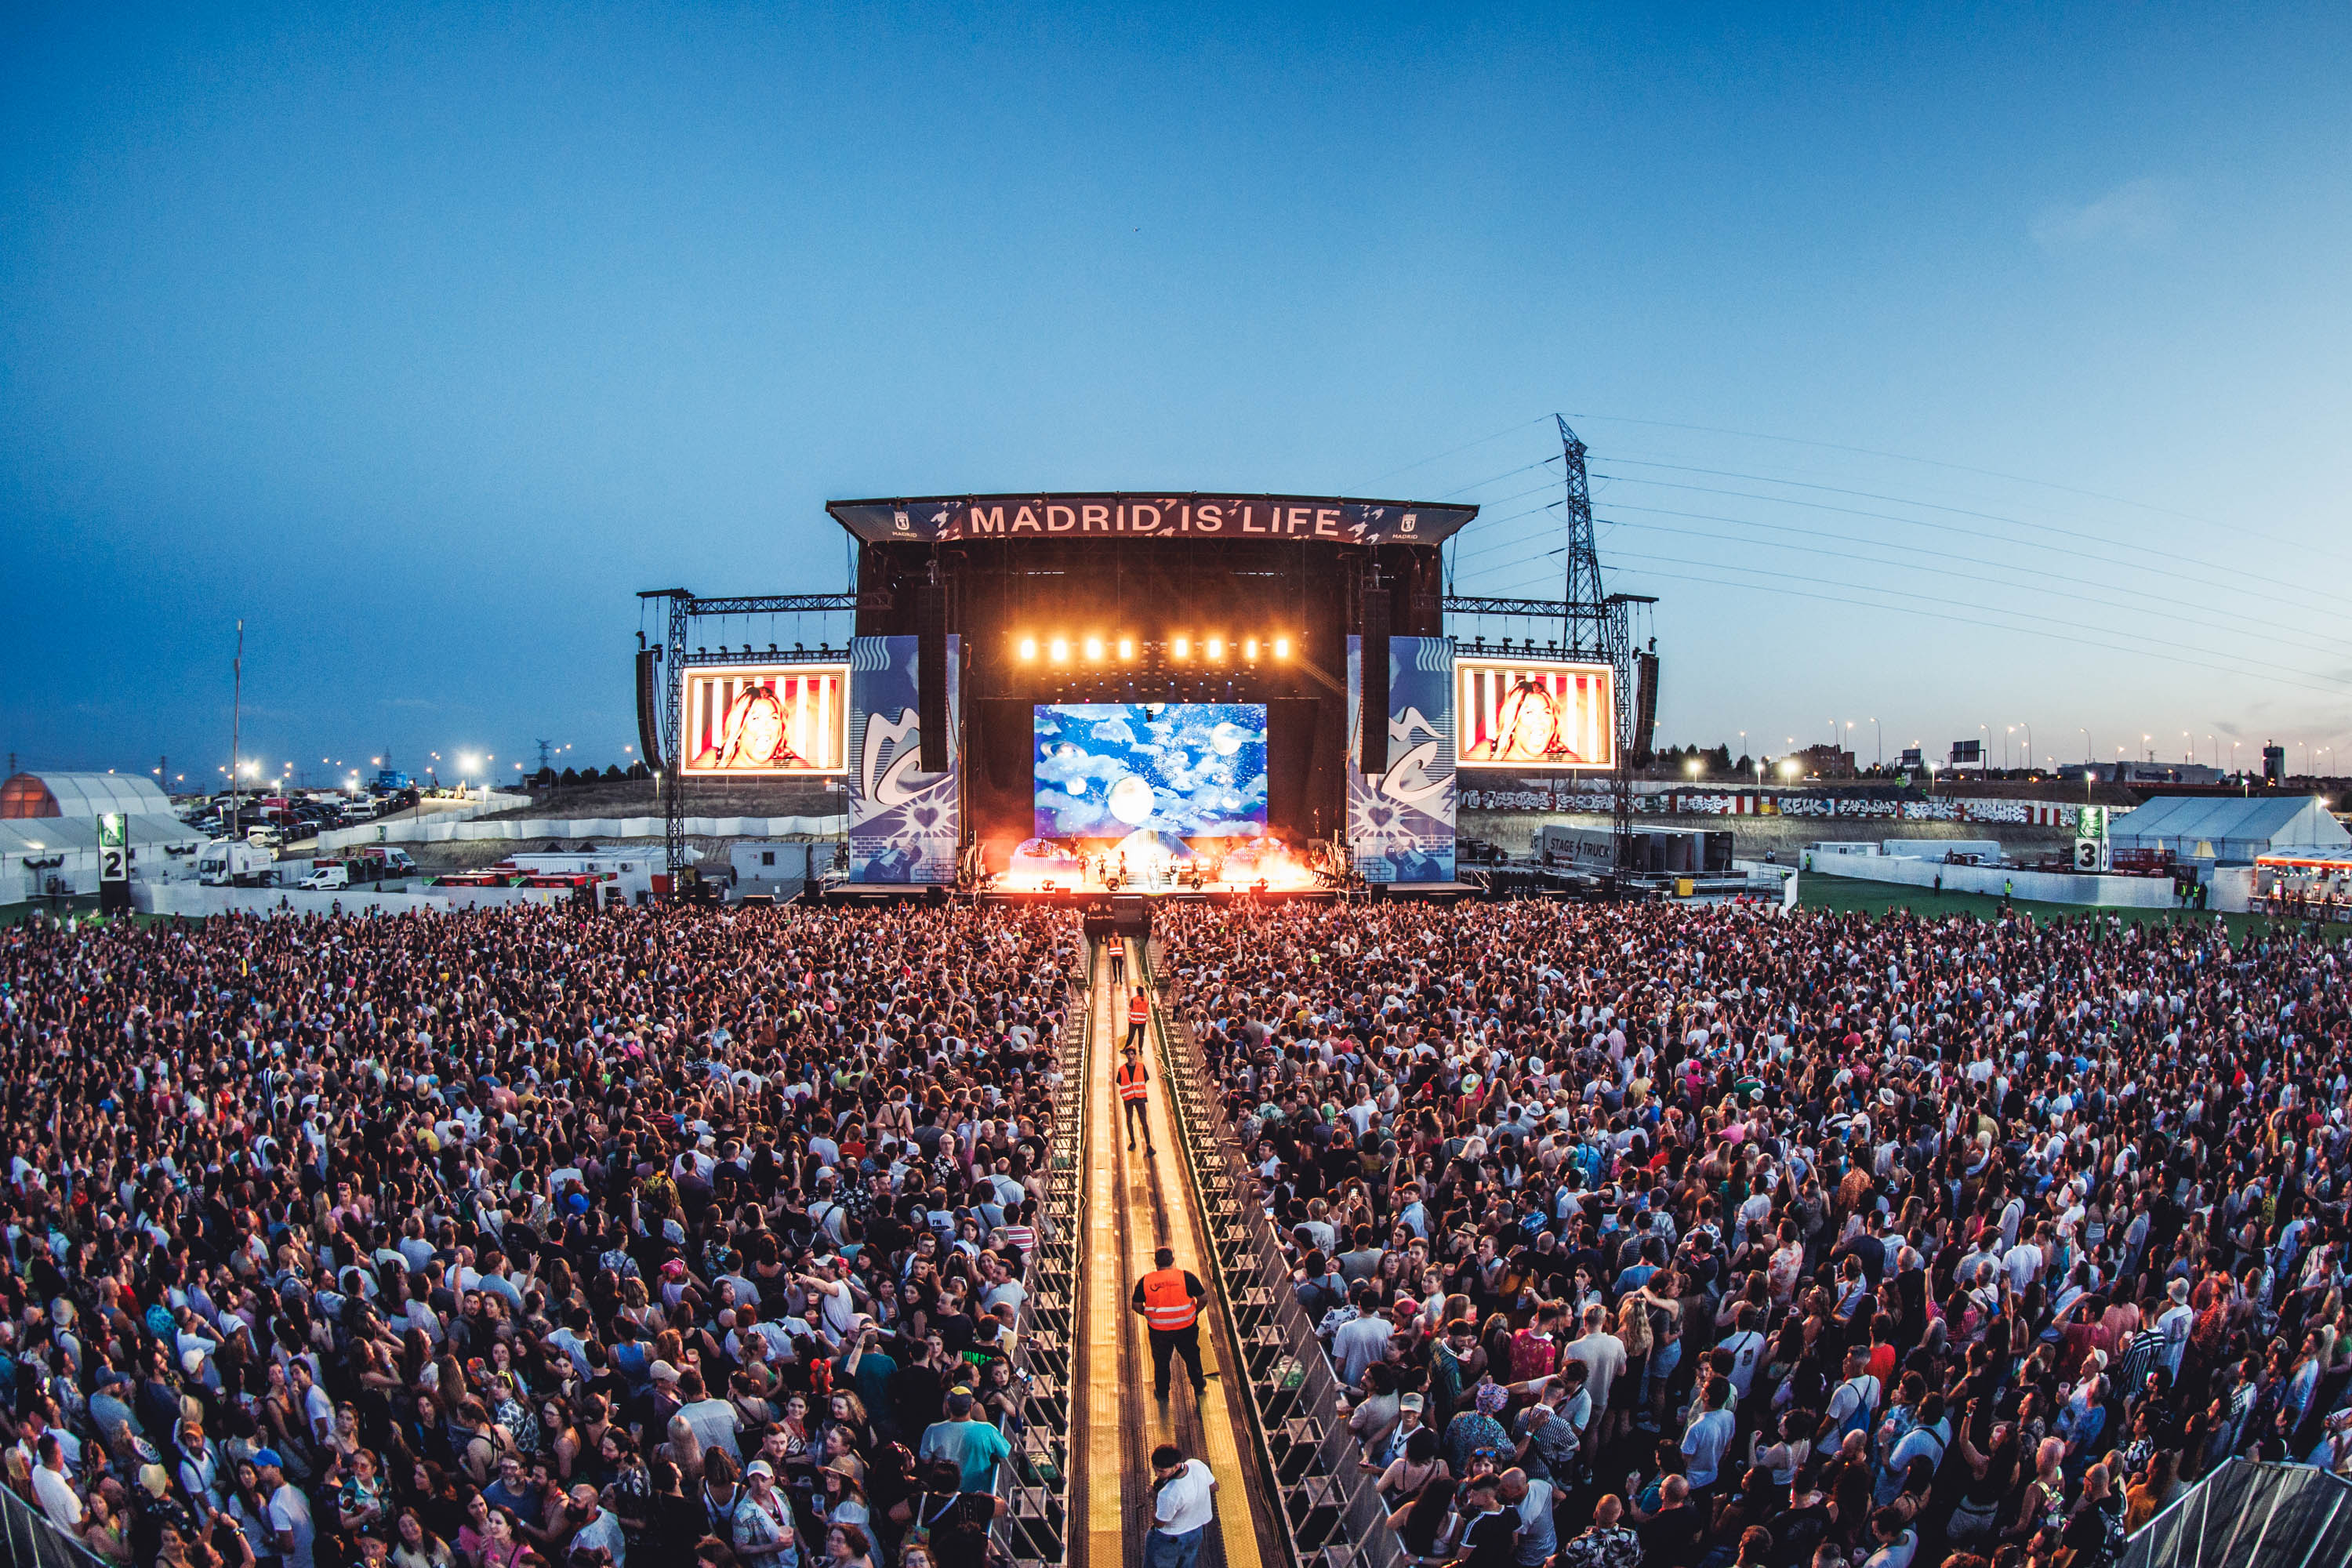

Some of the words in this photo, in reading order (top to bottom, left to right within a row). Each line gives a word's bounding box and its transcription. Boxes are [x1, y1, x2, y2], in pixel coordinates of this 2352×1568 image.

[970, 504, 1161, 533] MADRID
[1181, 504, 1223, 532] IS
[1243, 506, 1341, 537] LIFE
[1550, 837, 1575, 853] STAGE
[1583, 841, 1610, 859] TRUCK
[2078, 843, 2096, 868] 3
[2103, 843, 2108, 867] 3
[104, 851, 122, 877] 2
